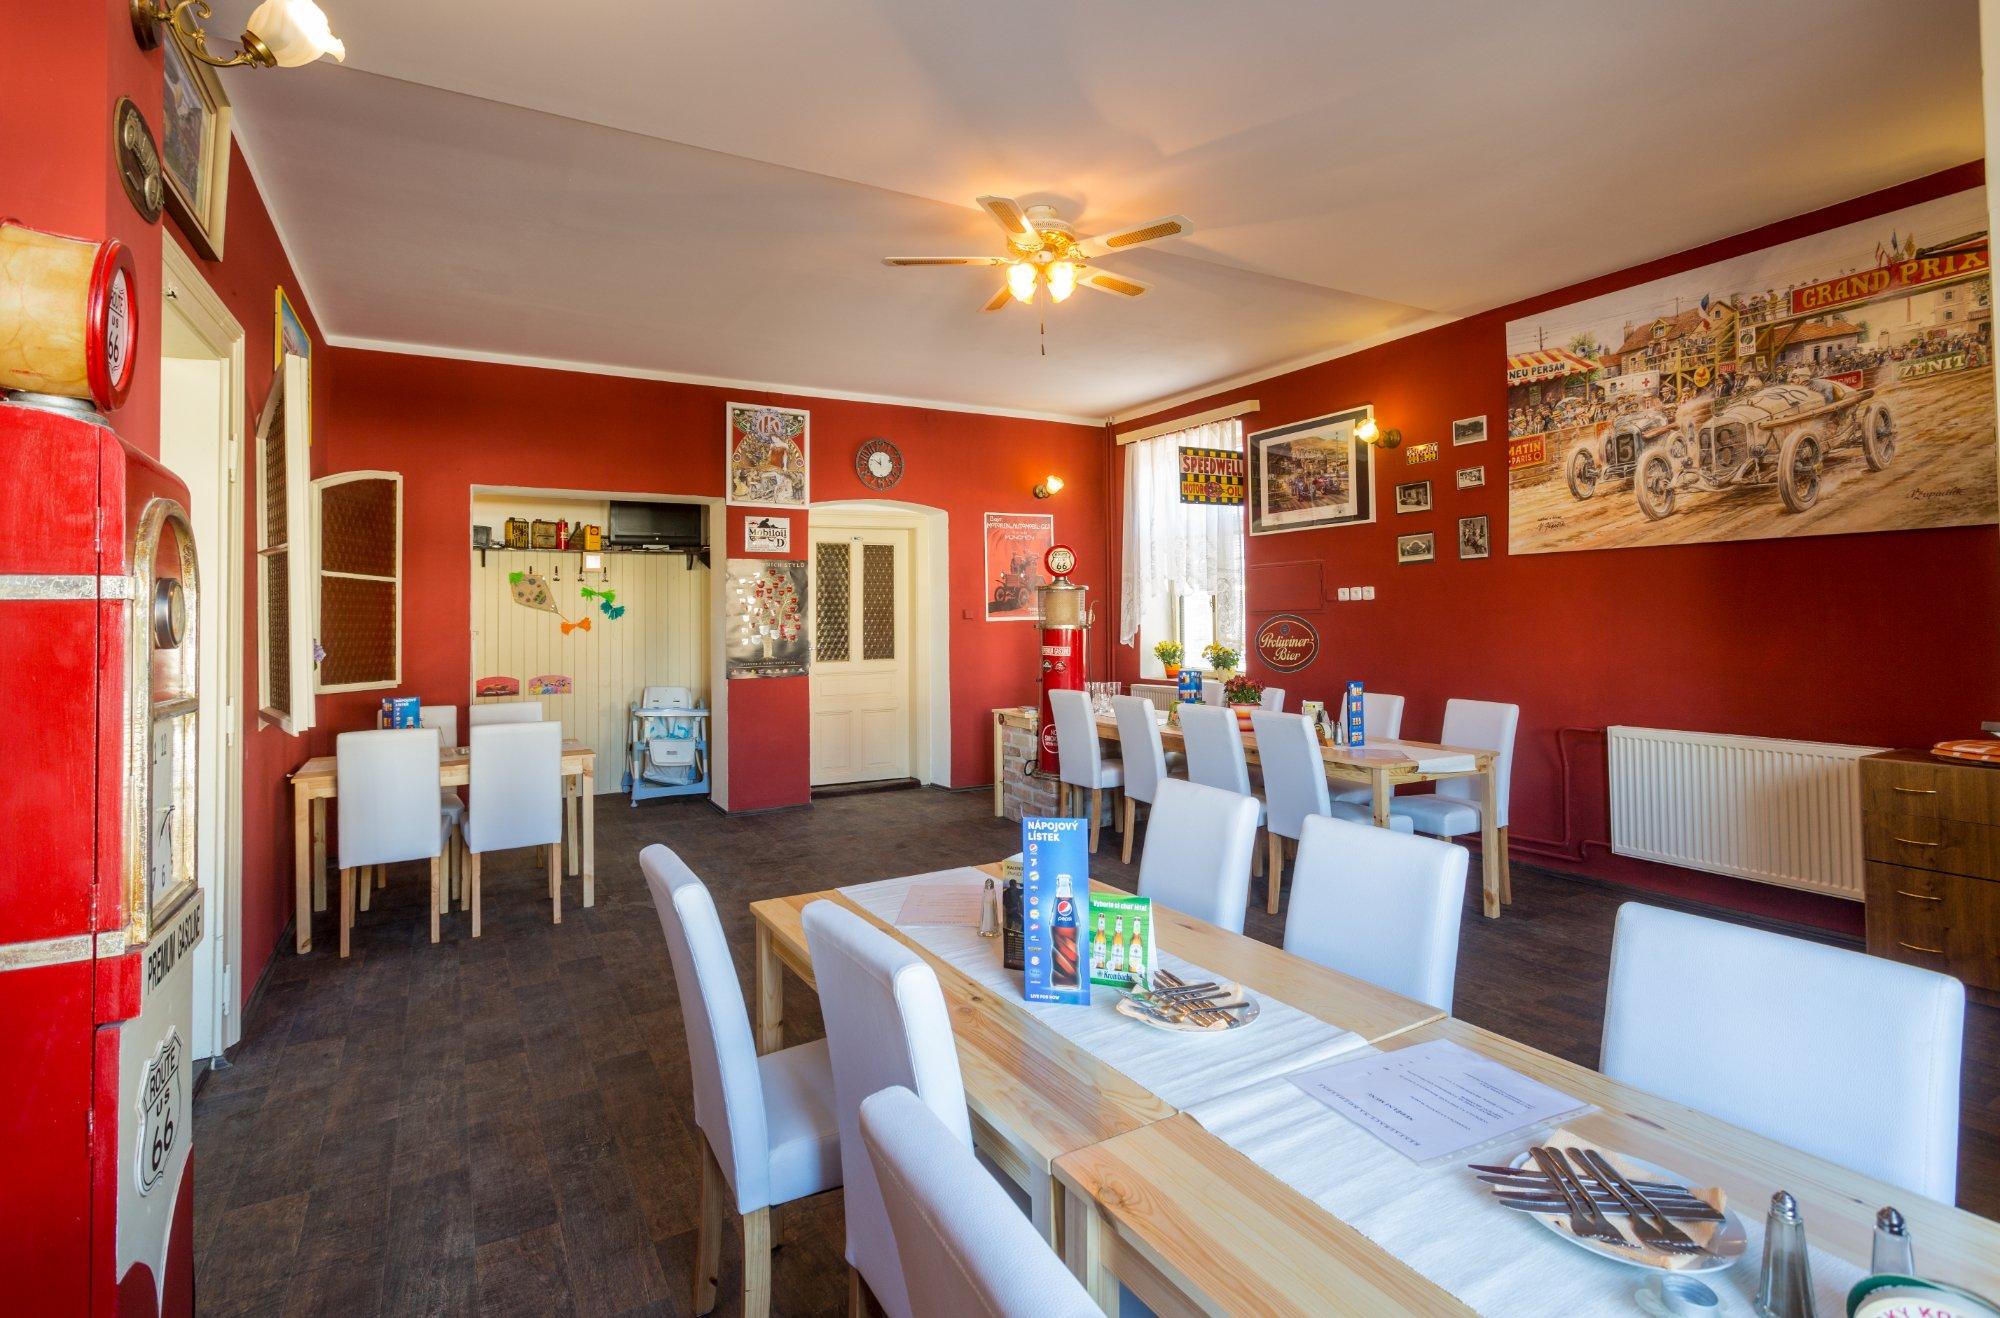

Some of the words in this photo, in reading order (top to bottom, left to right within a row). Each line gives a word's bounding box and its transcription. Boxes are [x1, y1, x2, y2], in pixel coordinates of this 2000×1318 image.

[1802, 269, 1891, 308] GRAND
[1900, 253, 1986, 285] PRIX
[108, 331, 119, 363] 66
[1507, 367, 1528, 380] NEU
[1531, 362, 1565, 375] PERSAN
[1183, 456, 1243, 476] SPEEDWELL
[1183, 483, 1205, 494] MOTOR
[1056, 561, 1068, 570] 66
[1273, 647, 1301, 661] Bier
[1027, 820, 1079, 832] NÁPOJOVÝ
[1027, 832, 1061, 842] LÍSTEK
[147, 929, 175, 996] PREMIUM
[178, 904, 200, 959] GASOLINE
[149, 1046, 176, 1103] ROUTE
[157, 1087, 170, 1117] US
[152, 1107, 174, 1172] 66
